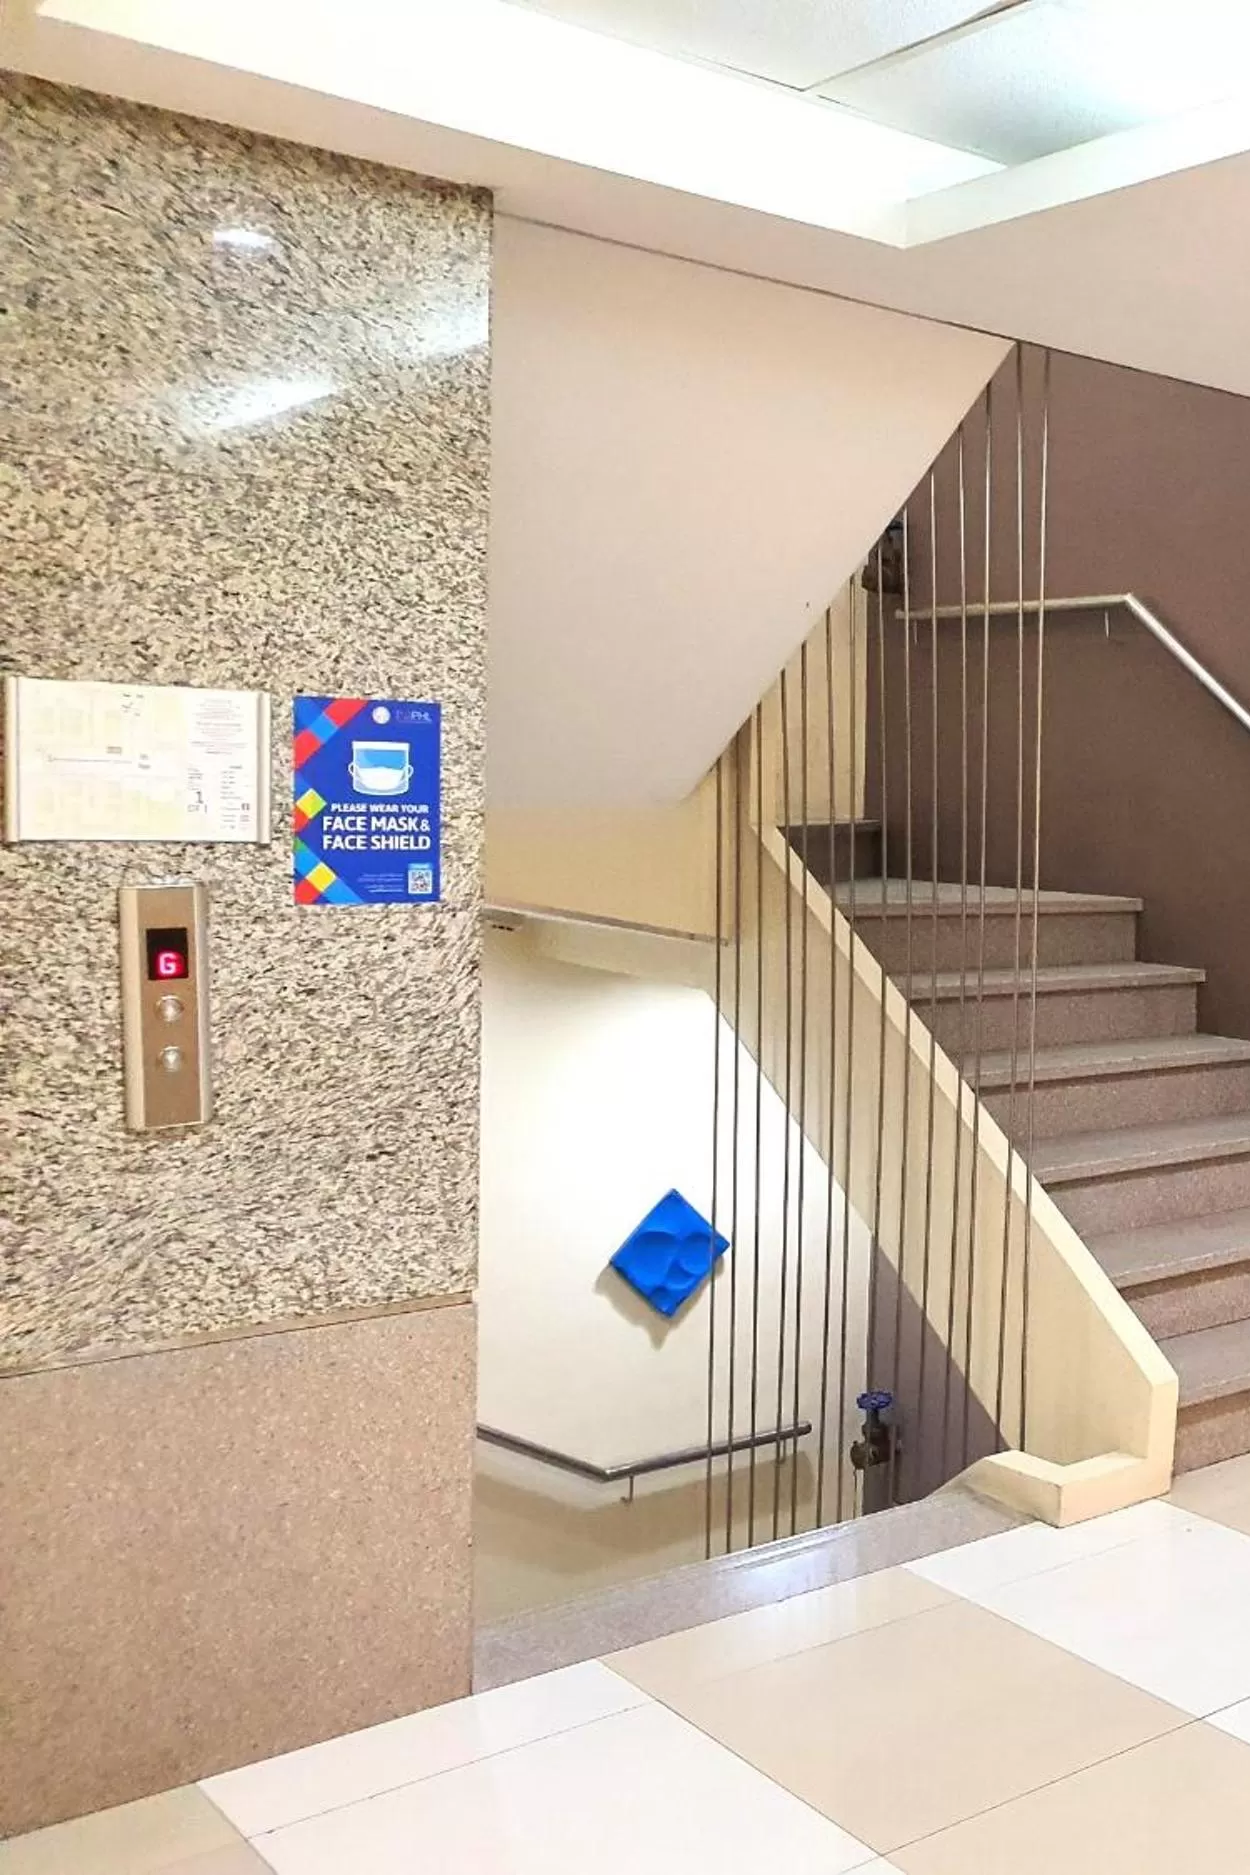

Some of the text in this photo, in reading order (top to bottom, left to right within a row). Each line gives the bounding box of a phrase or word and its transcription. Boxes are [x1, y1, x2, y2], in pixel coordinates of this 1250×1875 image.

[331, 803, 429, 814] PLEASE WEAR YOUR
[323, 816, 367, 832] FACE
[371, 816, 419, 832] MASK
[323, 835, 431, 850] FACE SHIELD
[159, 951, 177, 975] G
